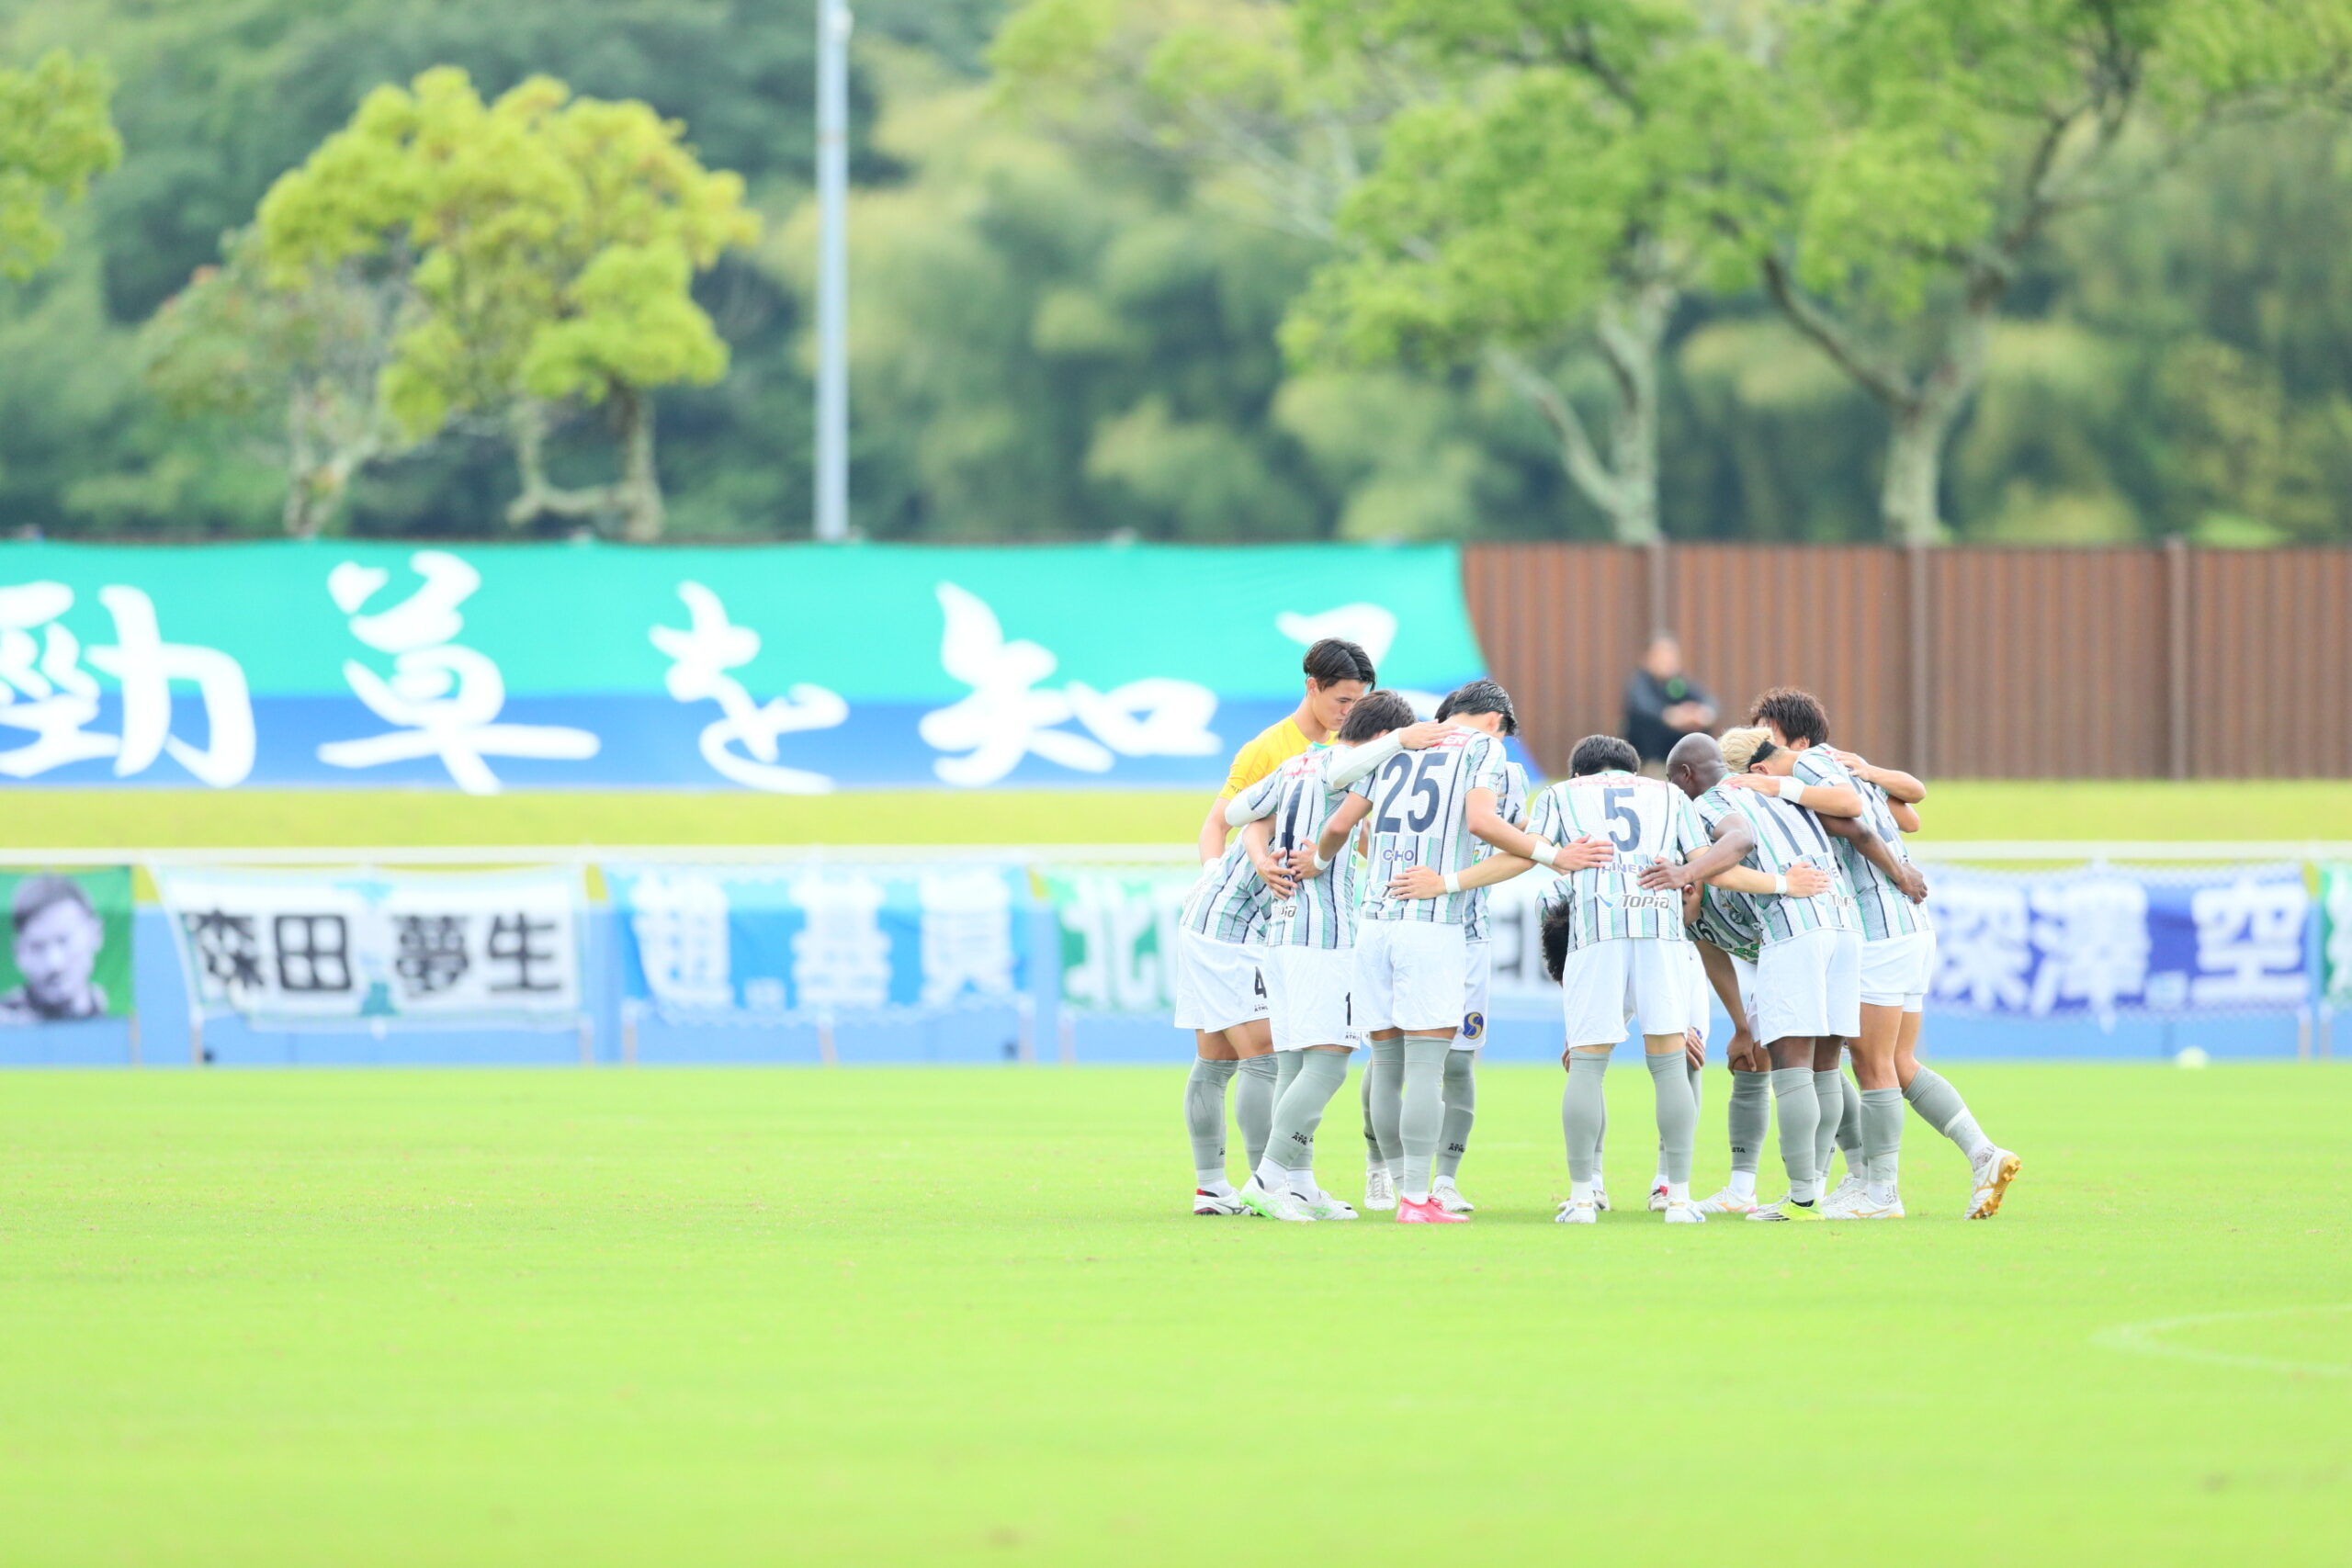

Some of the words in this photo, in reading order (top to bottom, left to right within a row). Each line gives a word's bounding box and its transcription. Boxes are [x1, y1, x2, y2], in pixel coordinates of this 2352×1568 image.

[1374, 751, 1449, 834] 25
[1603, 787, 1641, 852] 5
[1754, 791, 1828, 856] 11
[1383, 849, 1415, 862] CHO
